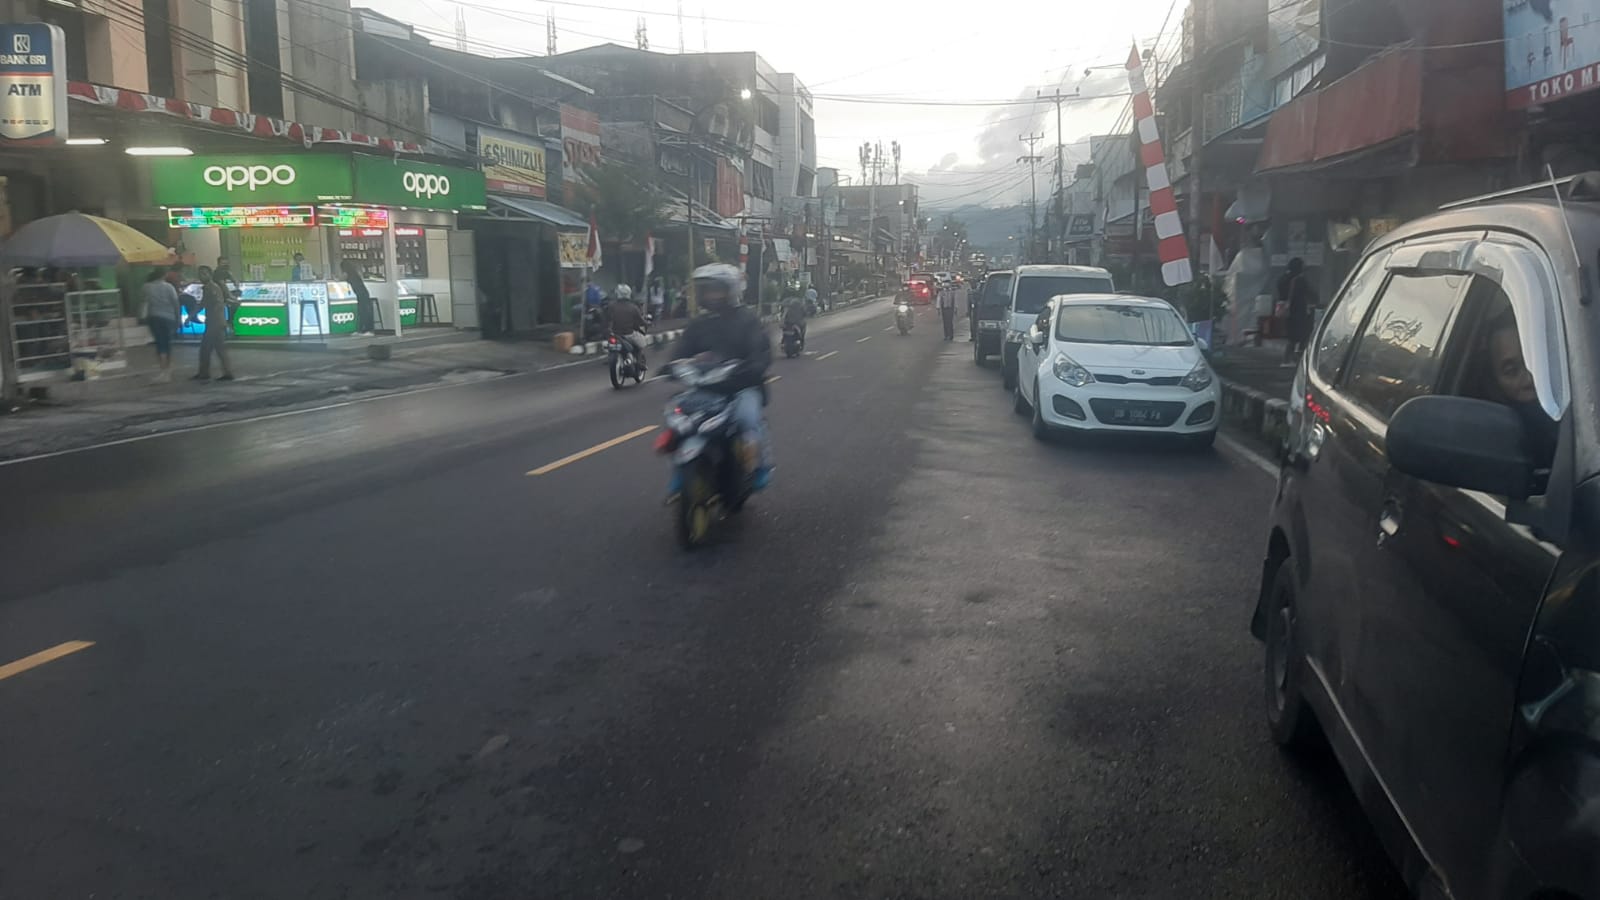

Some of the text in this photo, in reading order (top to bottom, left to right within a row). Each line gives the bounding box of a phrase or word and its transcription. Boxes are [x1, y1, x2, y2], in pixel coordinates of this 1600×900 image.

[29, 54, 46, 65] BRI
[7, 83, 42, 96] ATM
[1529, 74, 1574, 101] TOKO
[203, 164, 296, 192] oppo
[403, 171, 450, 199] oppo
[238, 316, 280, 326] oppo
[332, 312, 355, 324] oppo
